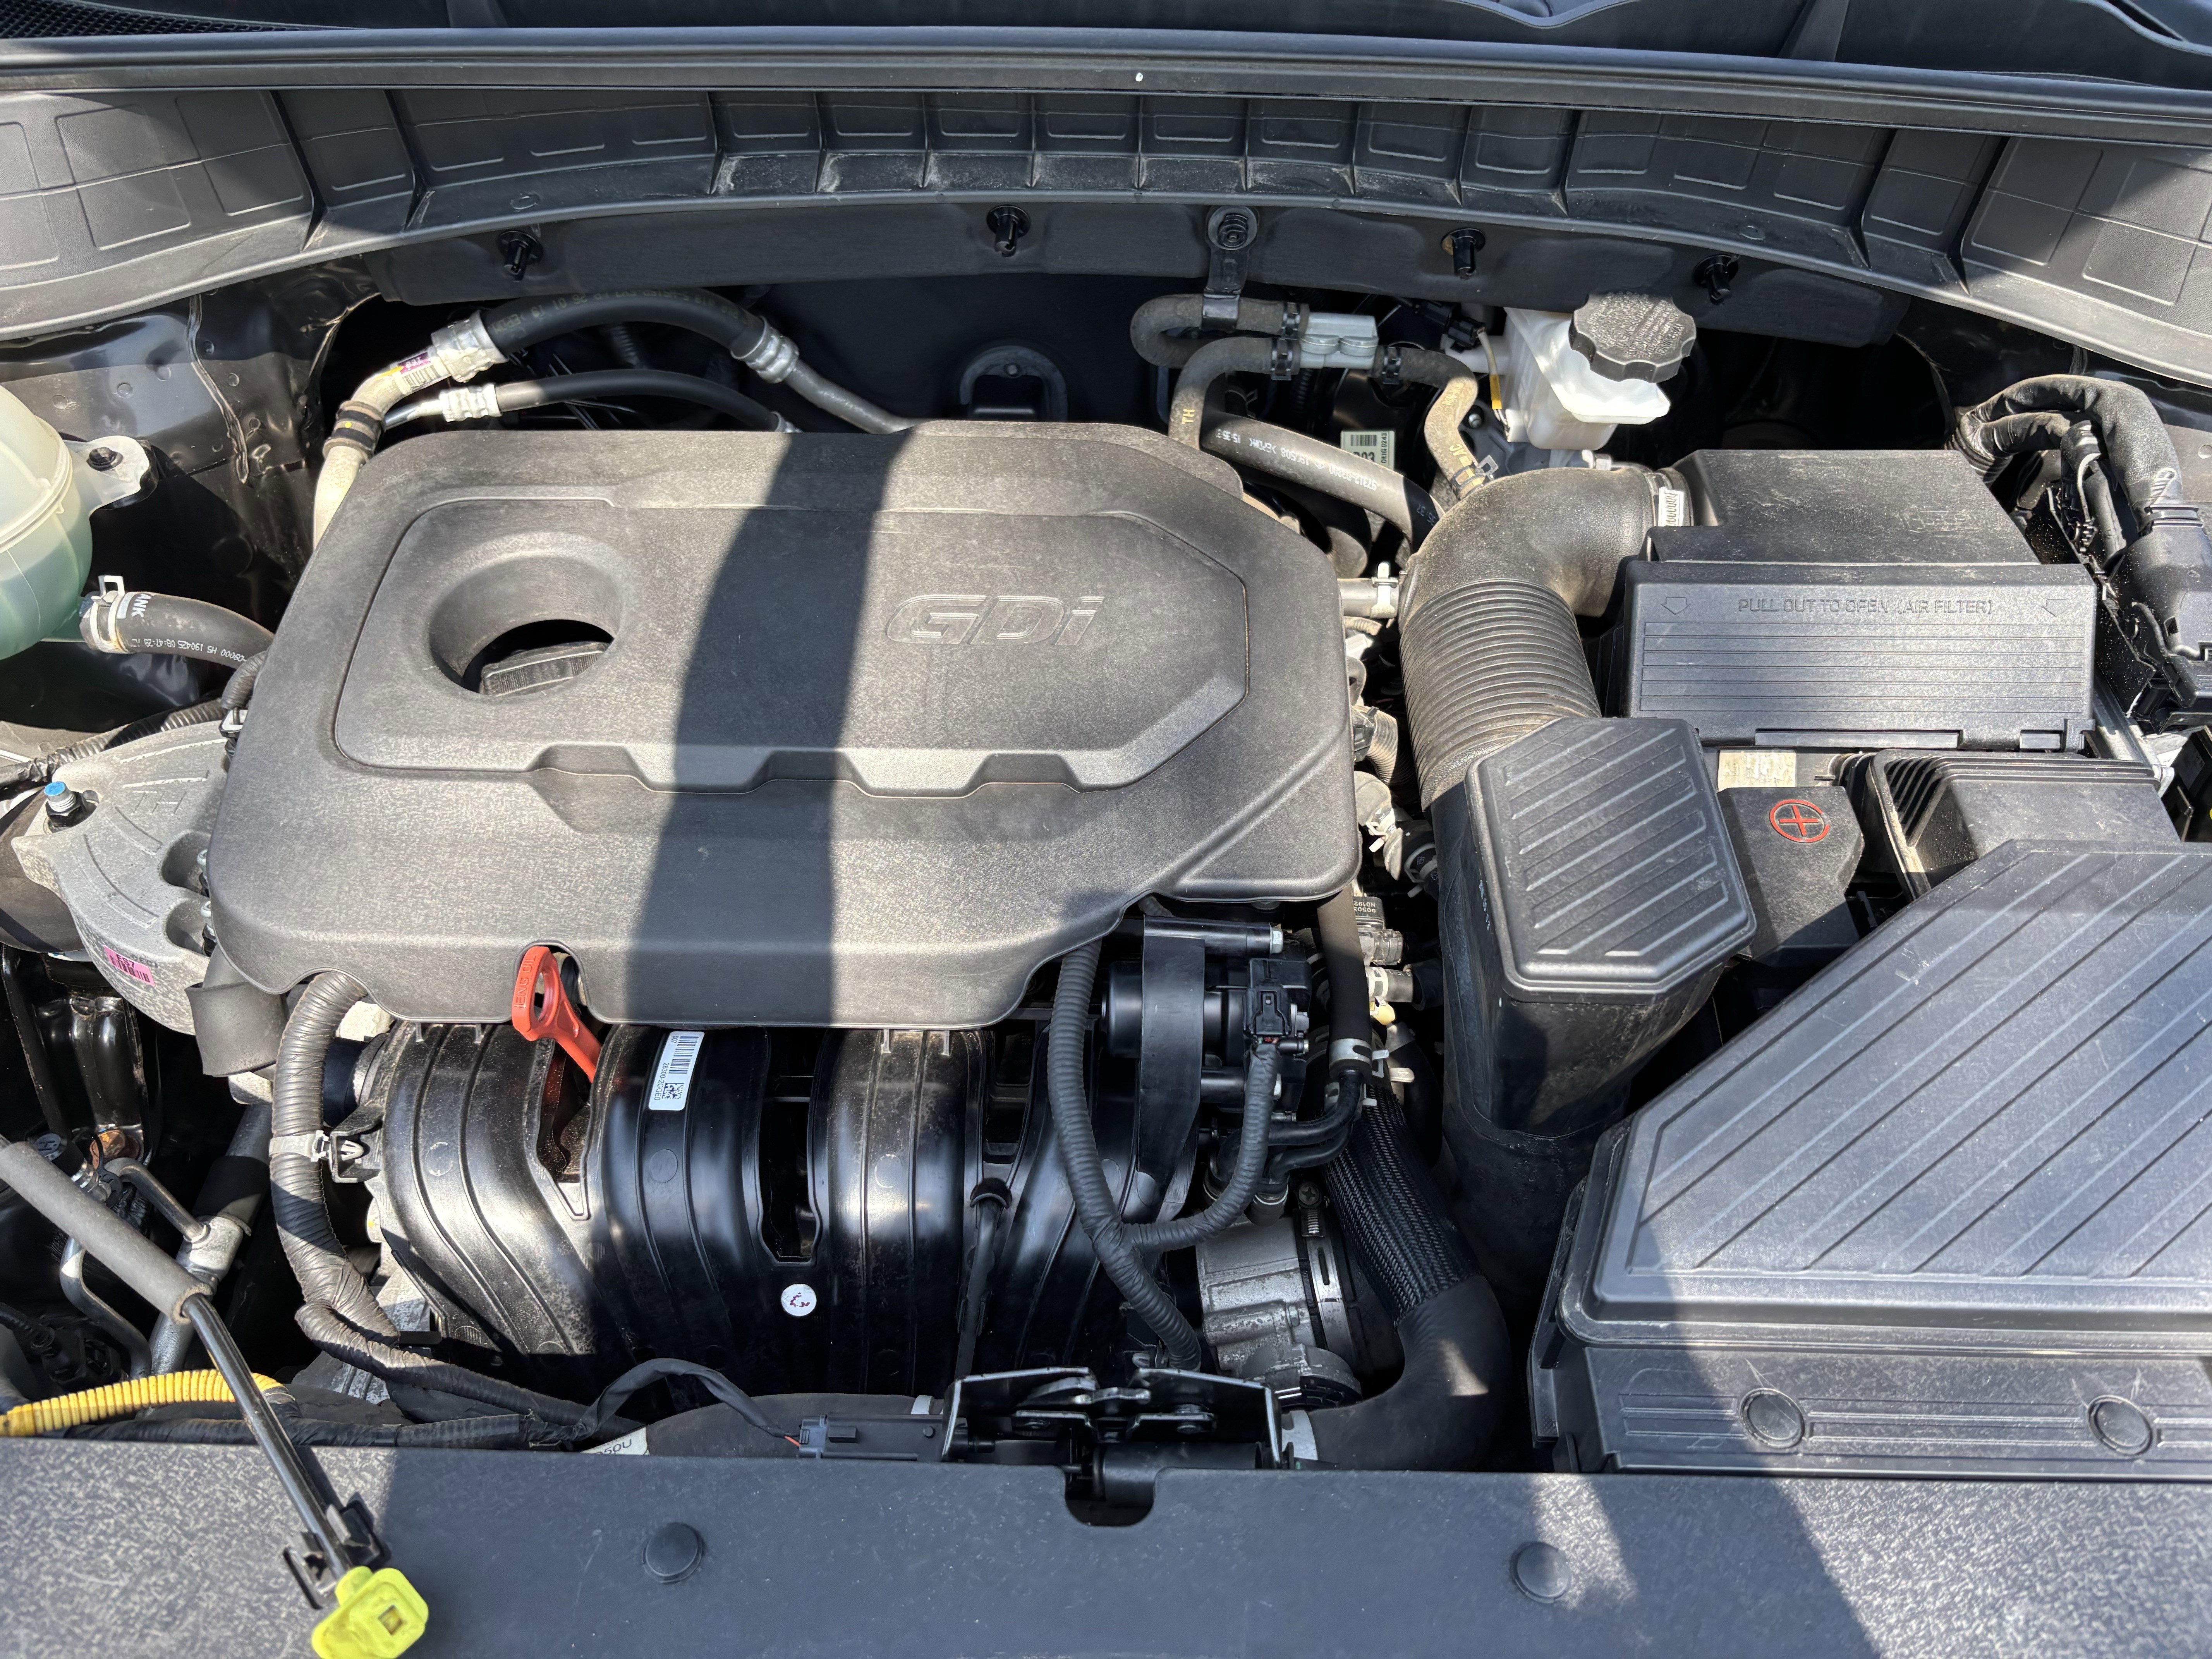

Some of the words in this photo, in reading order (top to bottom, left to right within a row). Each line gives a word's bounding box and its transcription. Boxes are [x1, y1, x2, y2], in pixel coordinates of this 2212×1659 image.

[1182, 409, 1195, 424] TH
[1449, 443, 1467, 456] AC
[1739, 599, 1780, 613] PULL
[1783, 599, 1816, 613] OUT
[1819, 599, 1840, 613] TO
[1845, 599, 1889, 613] OPEN
[884, 595, 1105, 645] GDi
[207, 645, 218, 655] HS
[514, 977, 529, 1006] ENG
[523, 955, 537, 973] OIL
